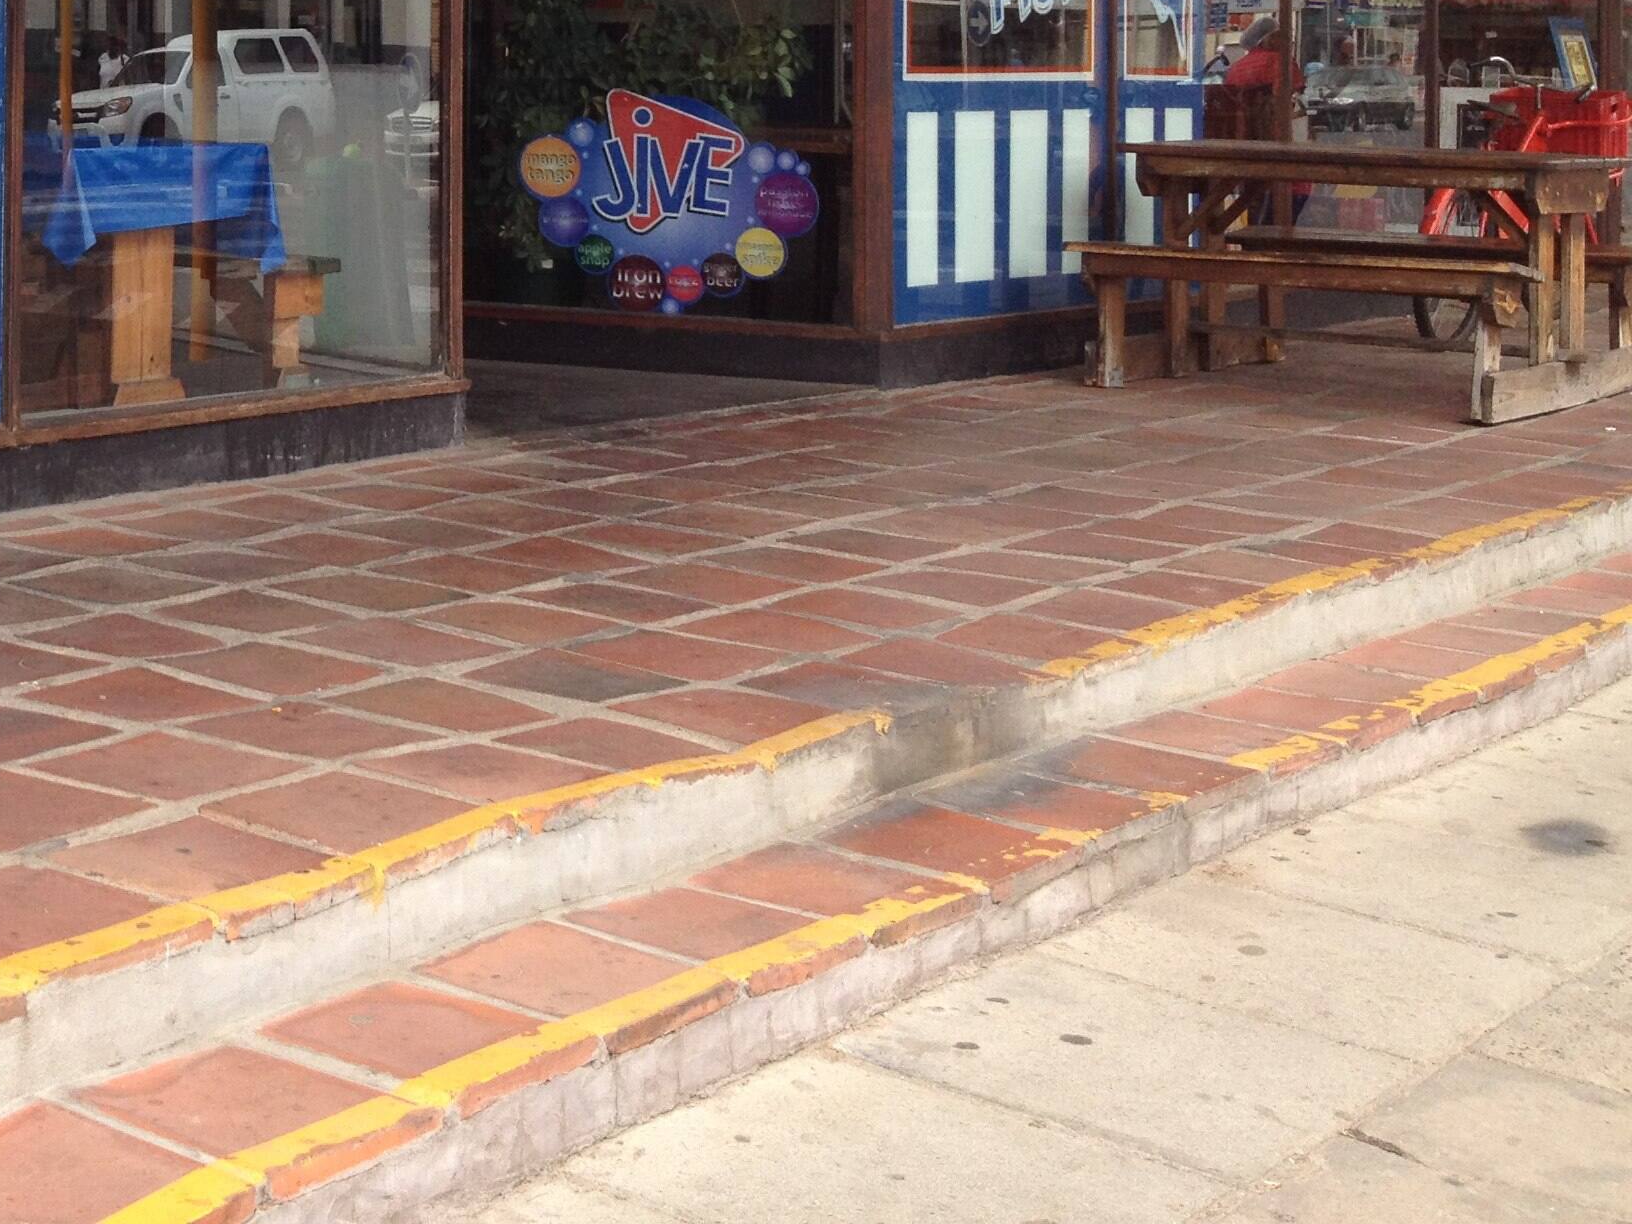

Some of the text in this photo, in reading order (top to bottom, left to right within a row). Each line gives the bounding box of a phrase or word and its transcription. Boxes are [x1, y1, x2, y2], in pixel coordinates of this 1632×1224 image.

[526, 152, 576, 168] mango
[528, 167, 575, 184] tango
[617, 267, 661, 284] iron
[706, 275, 739, 288] beer
[612, 283, 663, 300] brew
